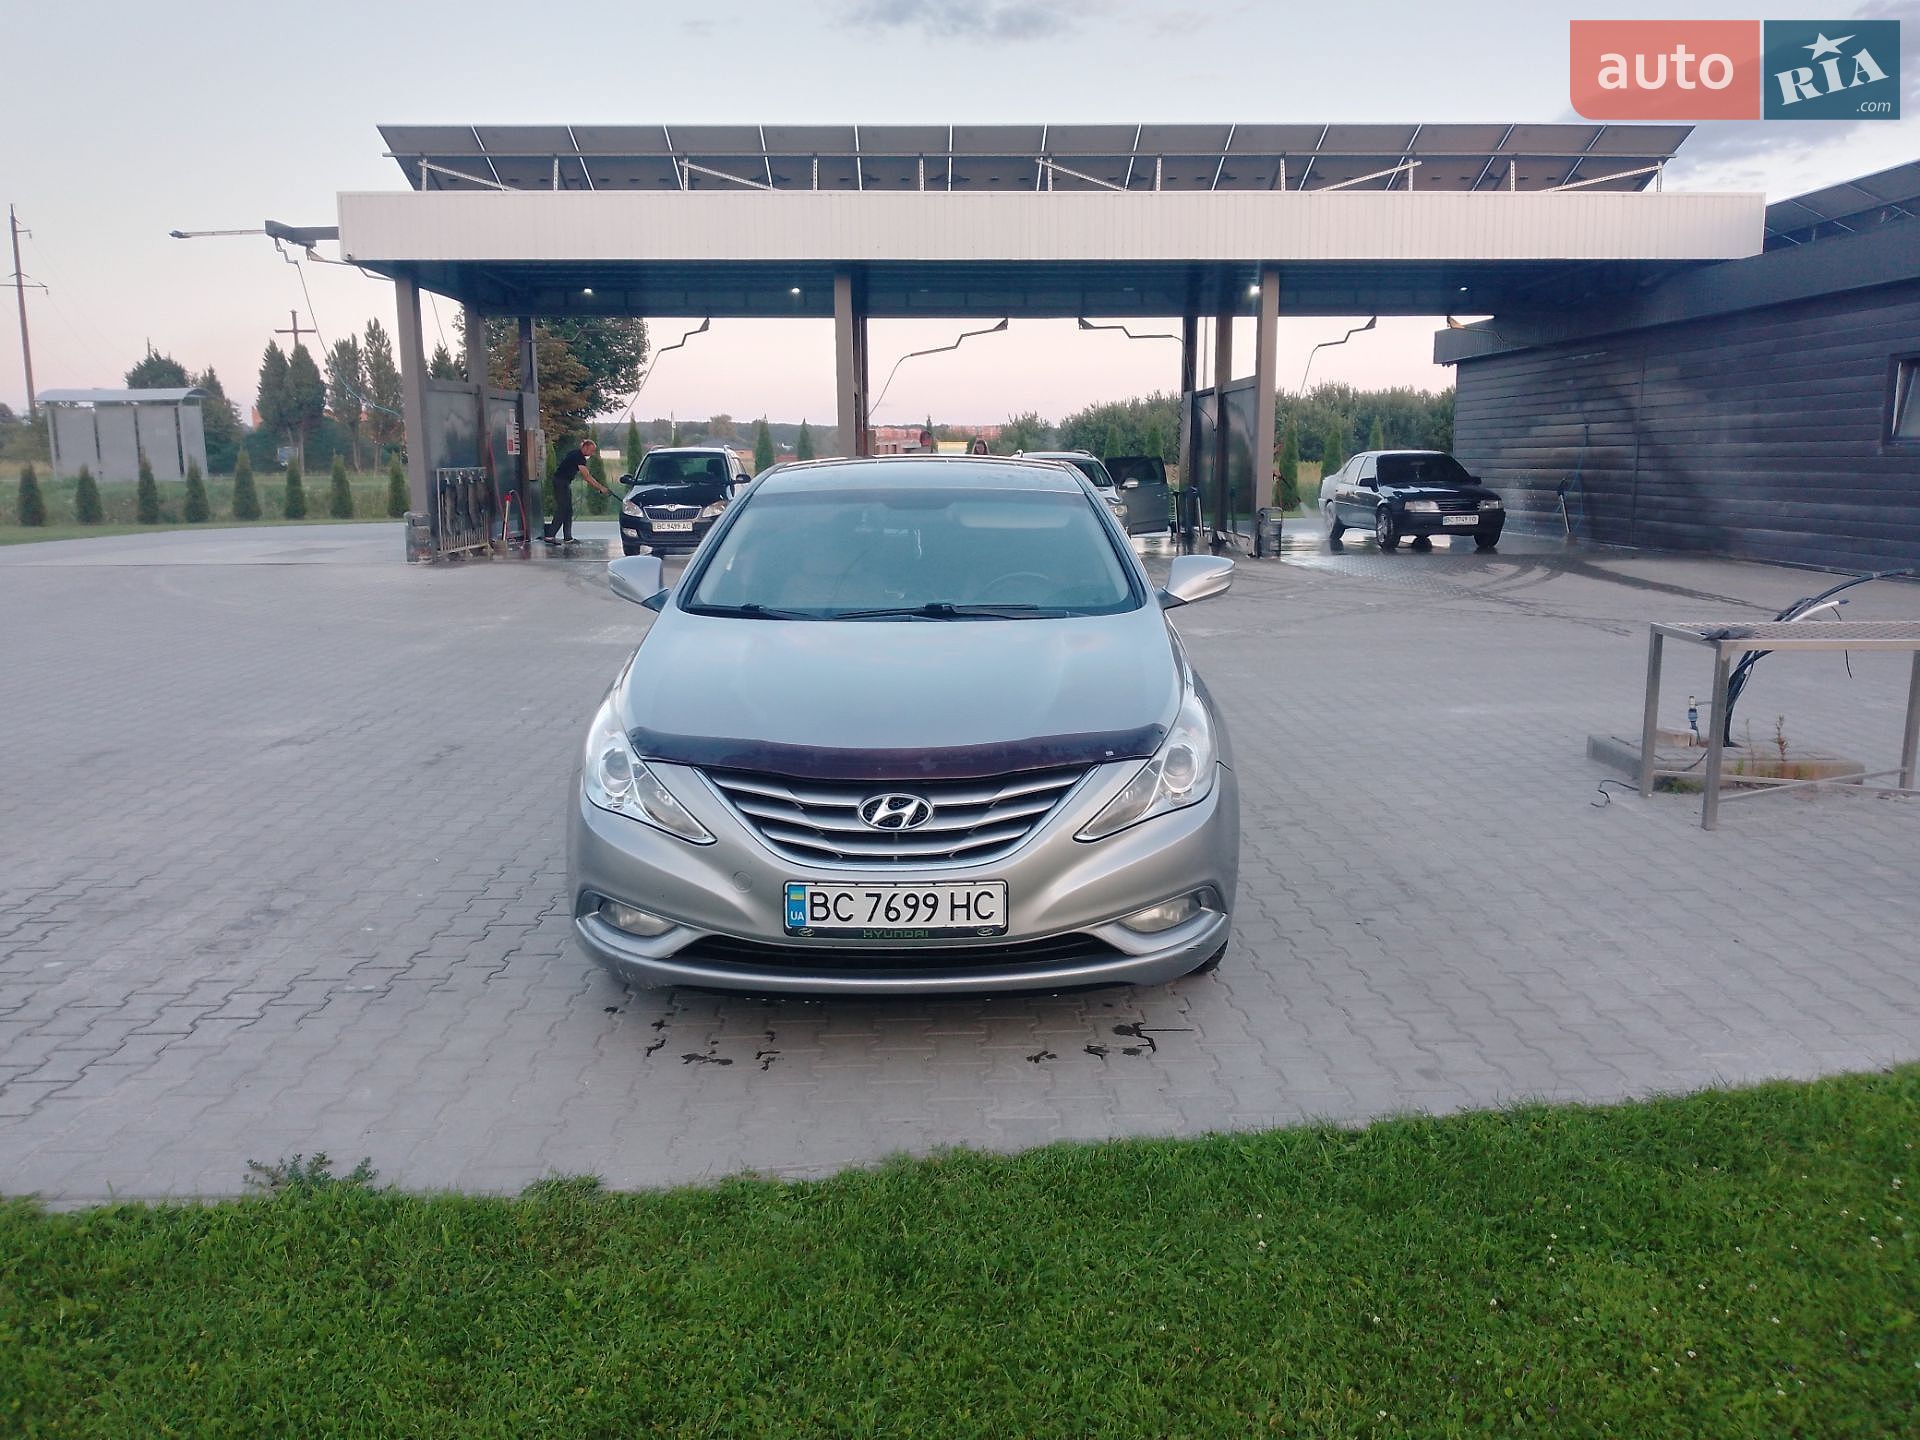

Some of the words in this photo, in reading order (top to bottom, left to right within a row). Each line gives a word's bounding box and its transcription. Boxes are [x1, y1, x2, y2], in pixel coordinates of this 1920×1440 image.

[809, 892, 855, 922] BC
[865, 892, 939, 922] 7699
[950, 891, 995, 921] HC
[790, 911, 805, 921] UA
[863, 929, 929, 939] HYUNDAI
